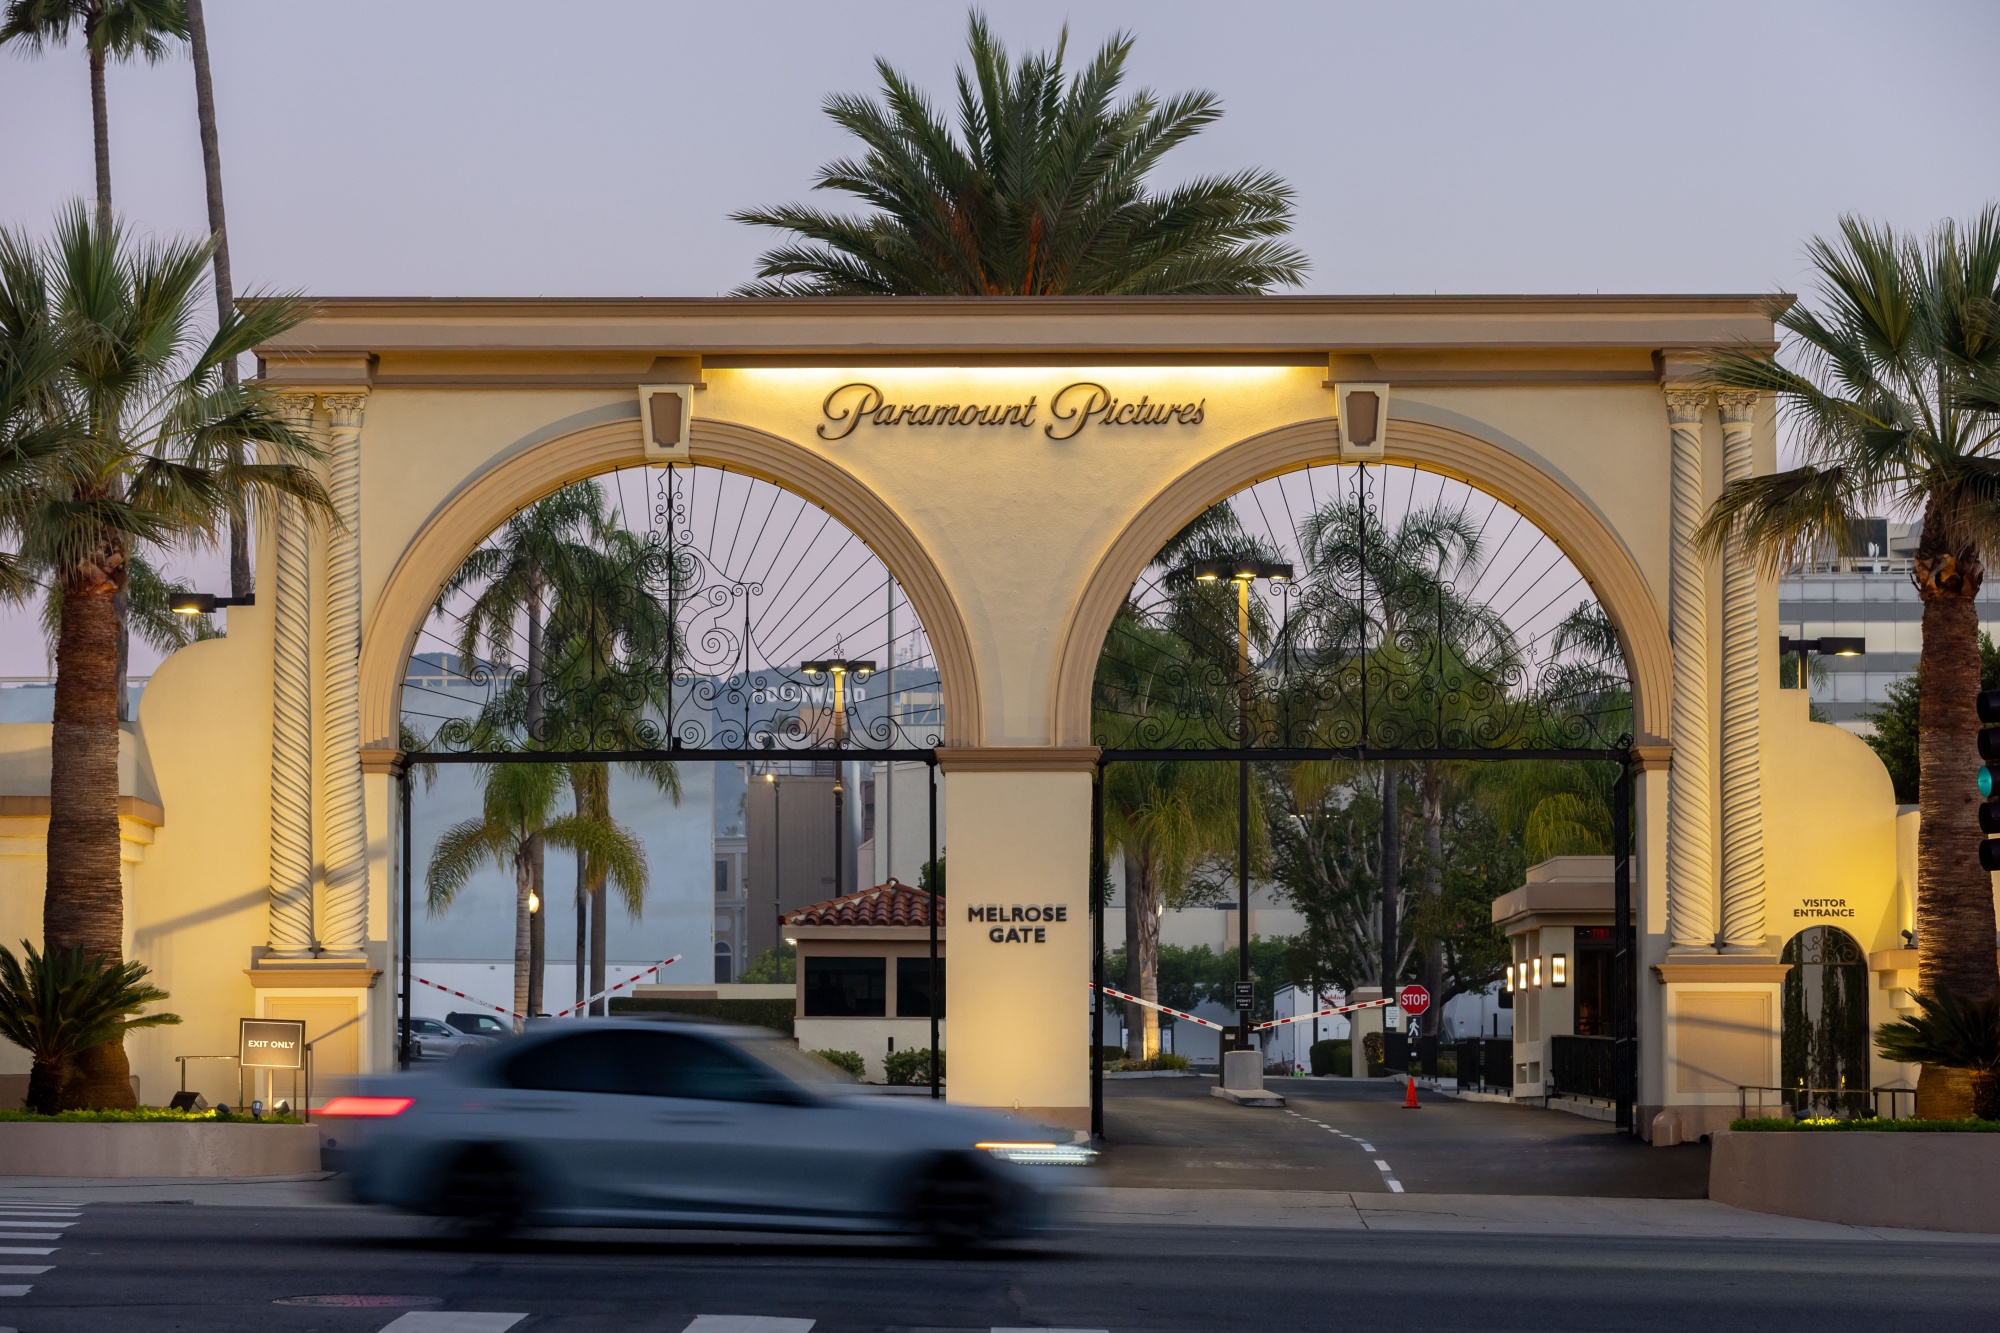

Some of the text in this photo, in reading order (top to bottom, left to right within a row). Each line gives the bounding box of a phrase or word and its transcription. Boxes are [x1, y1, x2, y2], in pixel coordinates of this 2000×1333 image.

[816, 382, 1206, 441] Paramount Pictures
[1802, 899, 1846, 908] VISITOR
[968, 904, 1067, 922] MELROSE
[1793, 909, 1855, 918] ENTRANCE
[989, 925, 1046, 943] GATE
[1401, 994, 1428, 1006] STOP
[248, 1040, 295, 1049] EXIT ONLY
